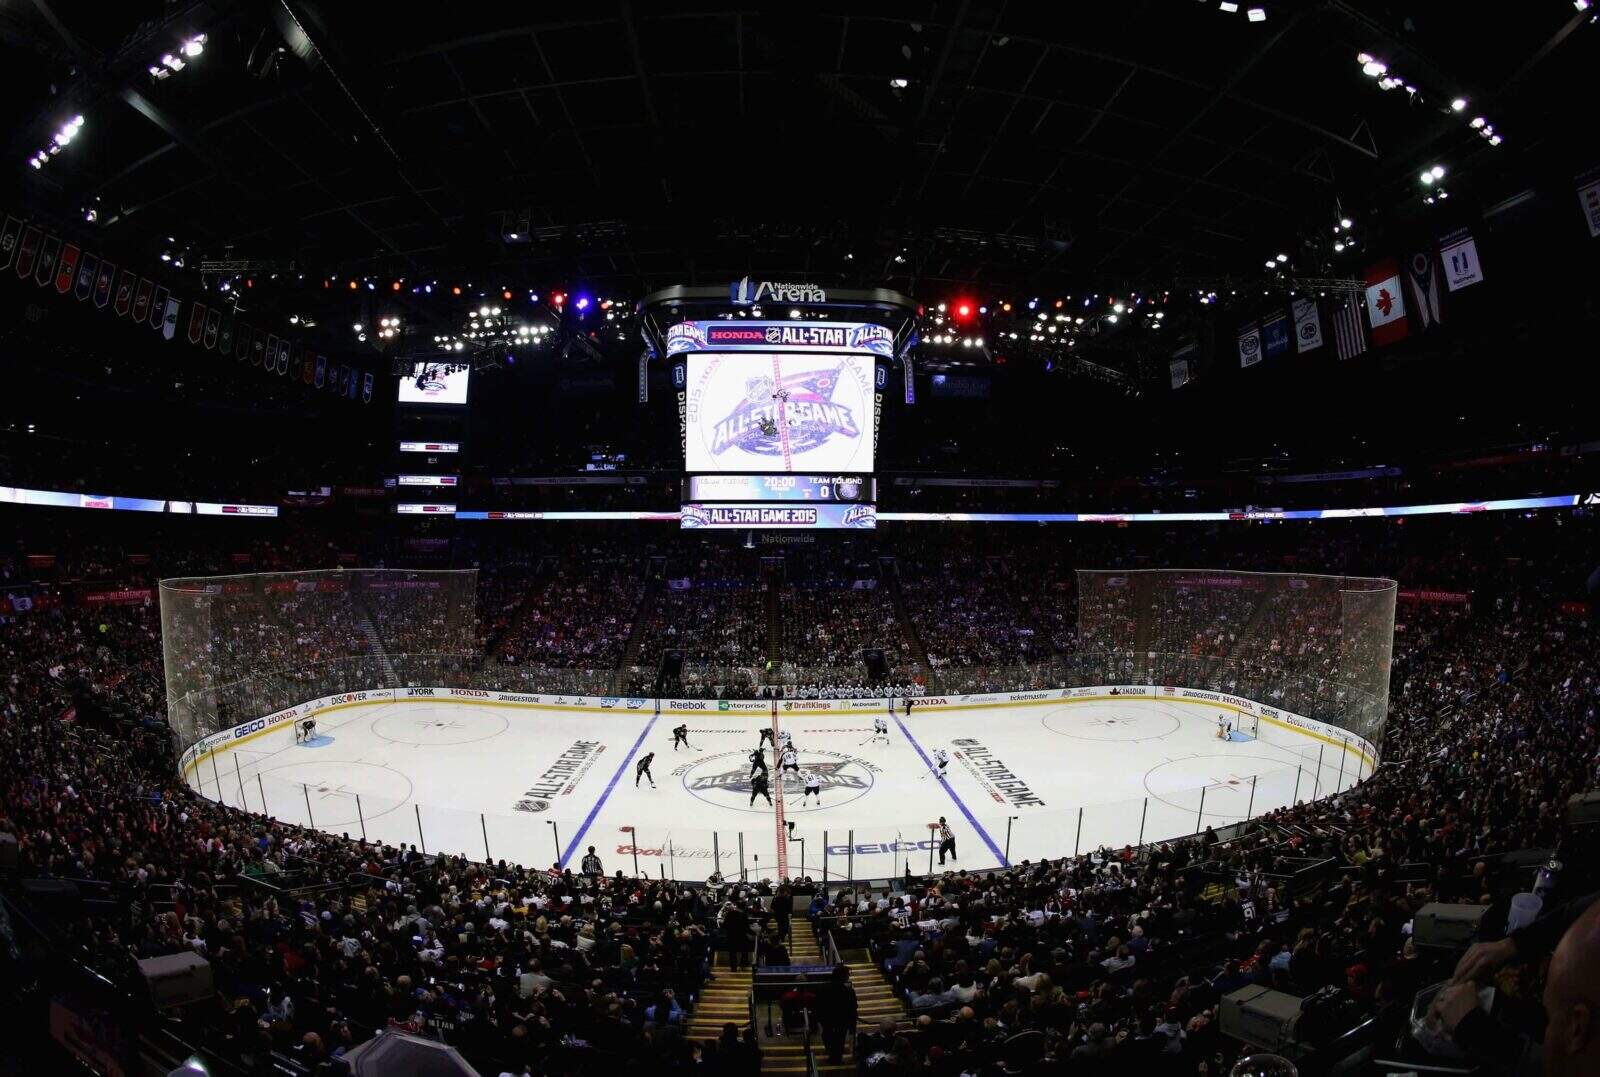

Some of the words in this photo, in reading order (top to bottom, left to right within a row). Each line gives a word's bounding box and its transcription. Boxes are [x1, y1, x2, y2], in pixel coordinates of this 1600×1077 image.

[754, 281, 826, 302] Arena
[711, 331, 764, 339] HONDA
[808, 477, 830, 485] TEAM
[820, 486, 829, 498] 0
[760, 508, 791, 523] GAME
[792, 508, 816, 522] 2015
[761, 532, 816, 545] Nationwide
[413, 688, 434, 696] YORK
[449, 689, 490, 697] HONDA
[1119, 687, 1146, 696] CANADIAN
[331, 692, 367, 705] DISCOVER
[498, 694, 540, 703] BRIDGESTONE
[1010, 693, 1048, 701] ticketmaster
[601, 699, 615, 708] SAP
[627, 700, 643, 708] SAP
[670, 701, 706, 710] Reebok
[1222, 696, 1253, 710] HONDA
[268, 709, 298, 725] HONDA
[234, 719, 265, 739] GEICO
[560, 739, 600, 760] GAME
[827, 839, 943, 856] GEICO
